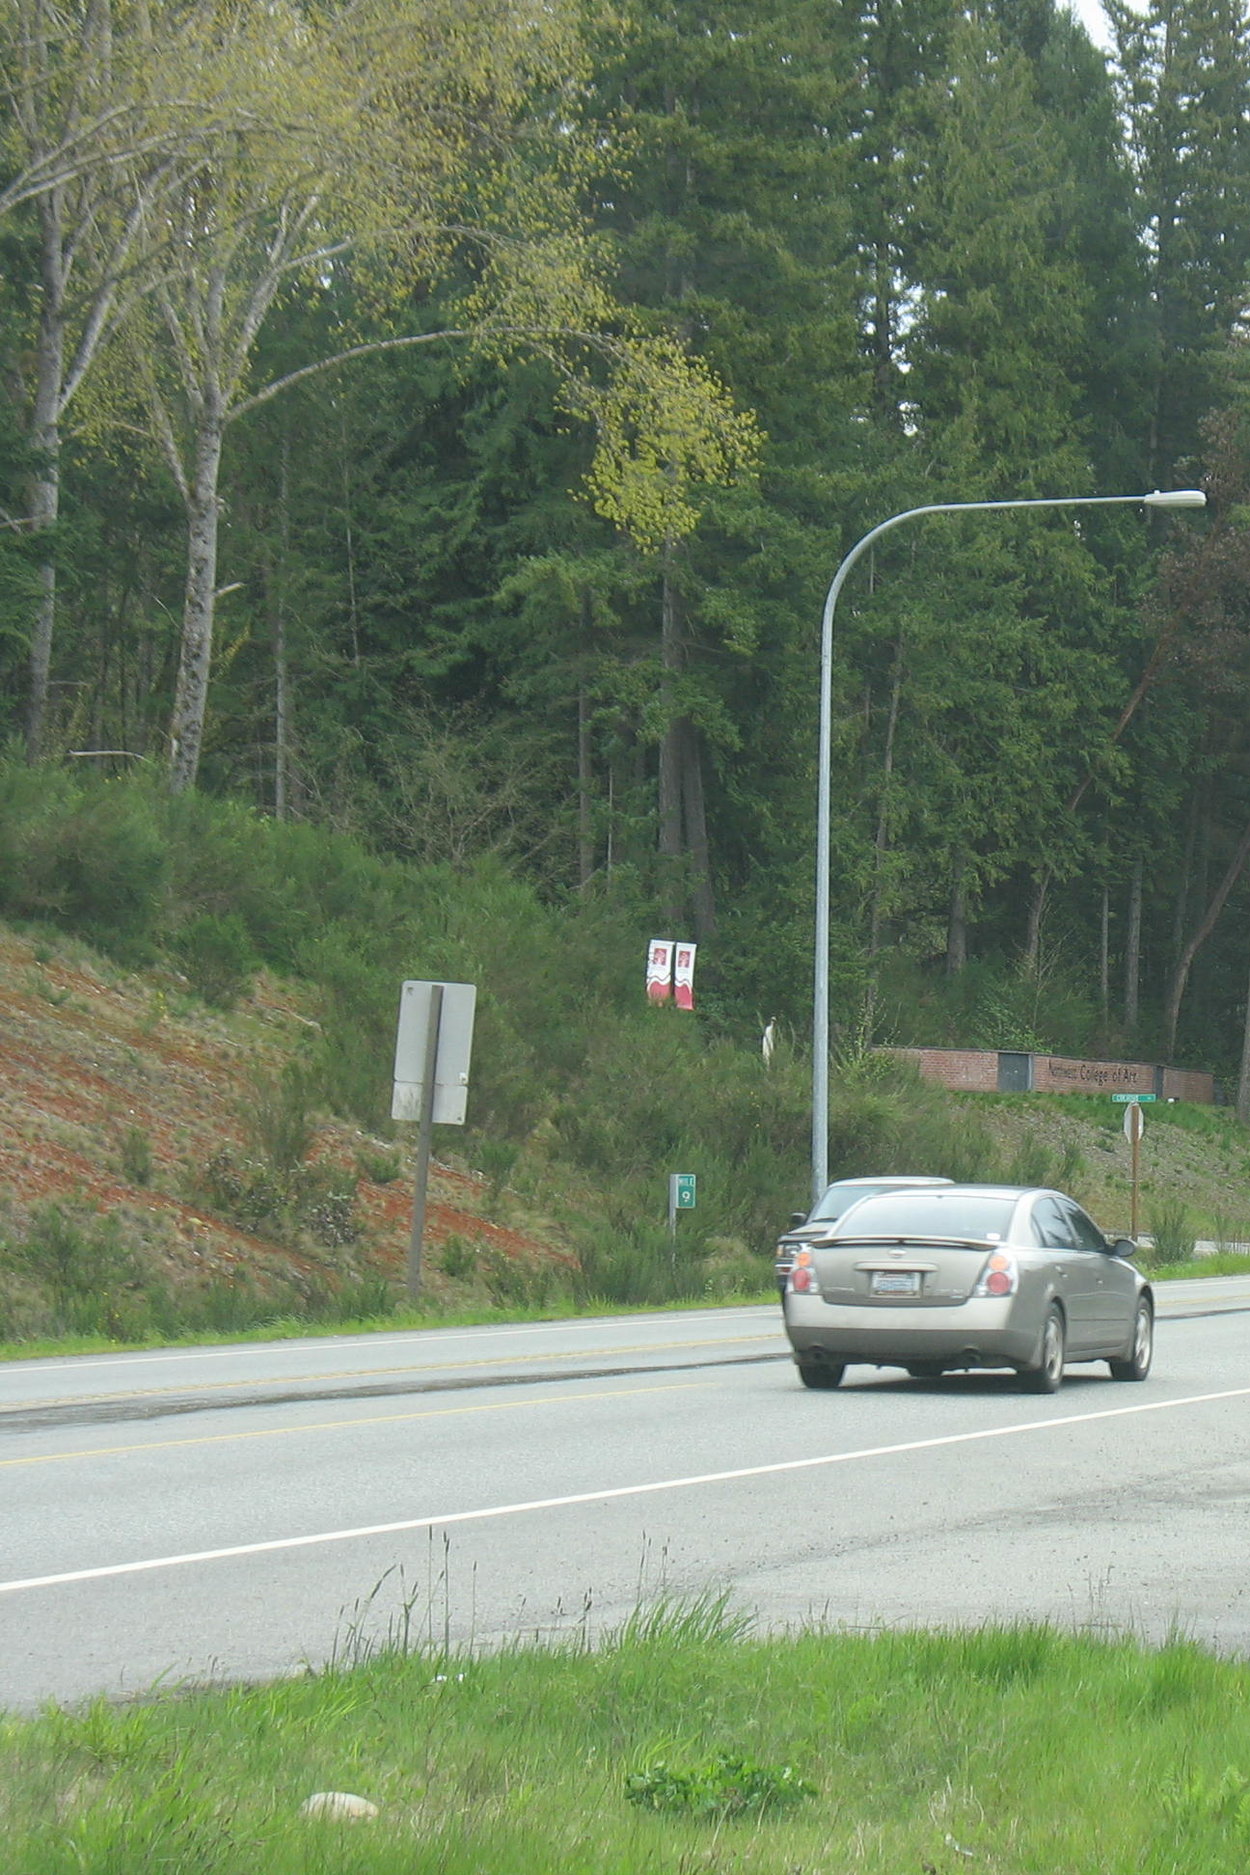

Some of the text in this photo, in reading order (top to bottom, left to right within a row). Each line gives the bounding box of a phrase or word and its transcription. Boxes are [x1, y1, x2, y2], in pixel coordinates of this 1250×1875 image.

[1080, 1064, 1108, 1086] College
[1111, 1068, 1121, 1082] of
[682, 1191, 691, 1203] 9
